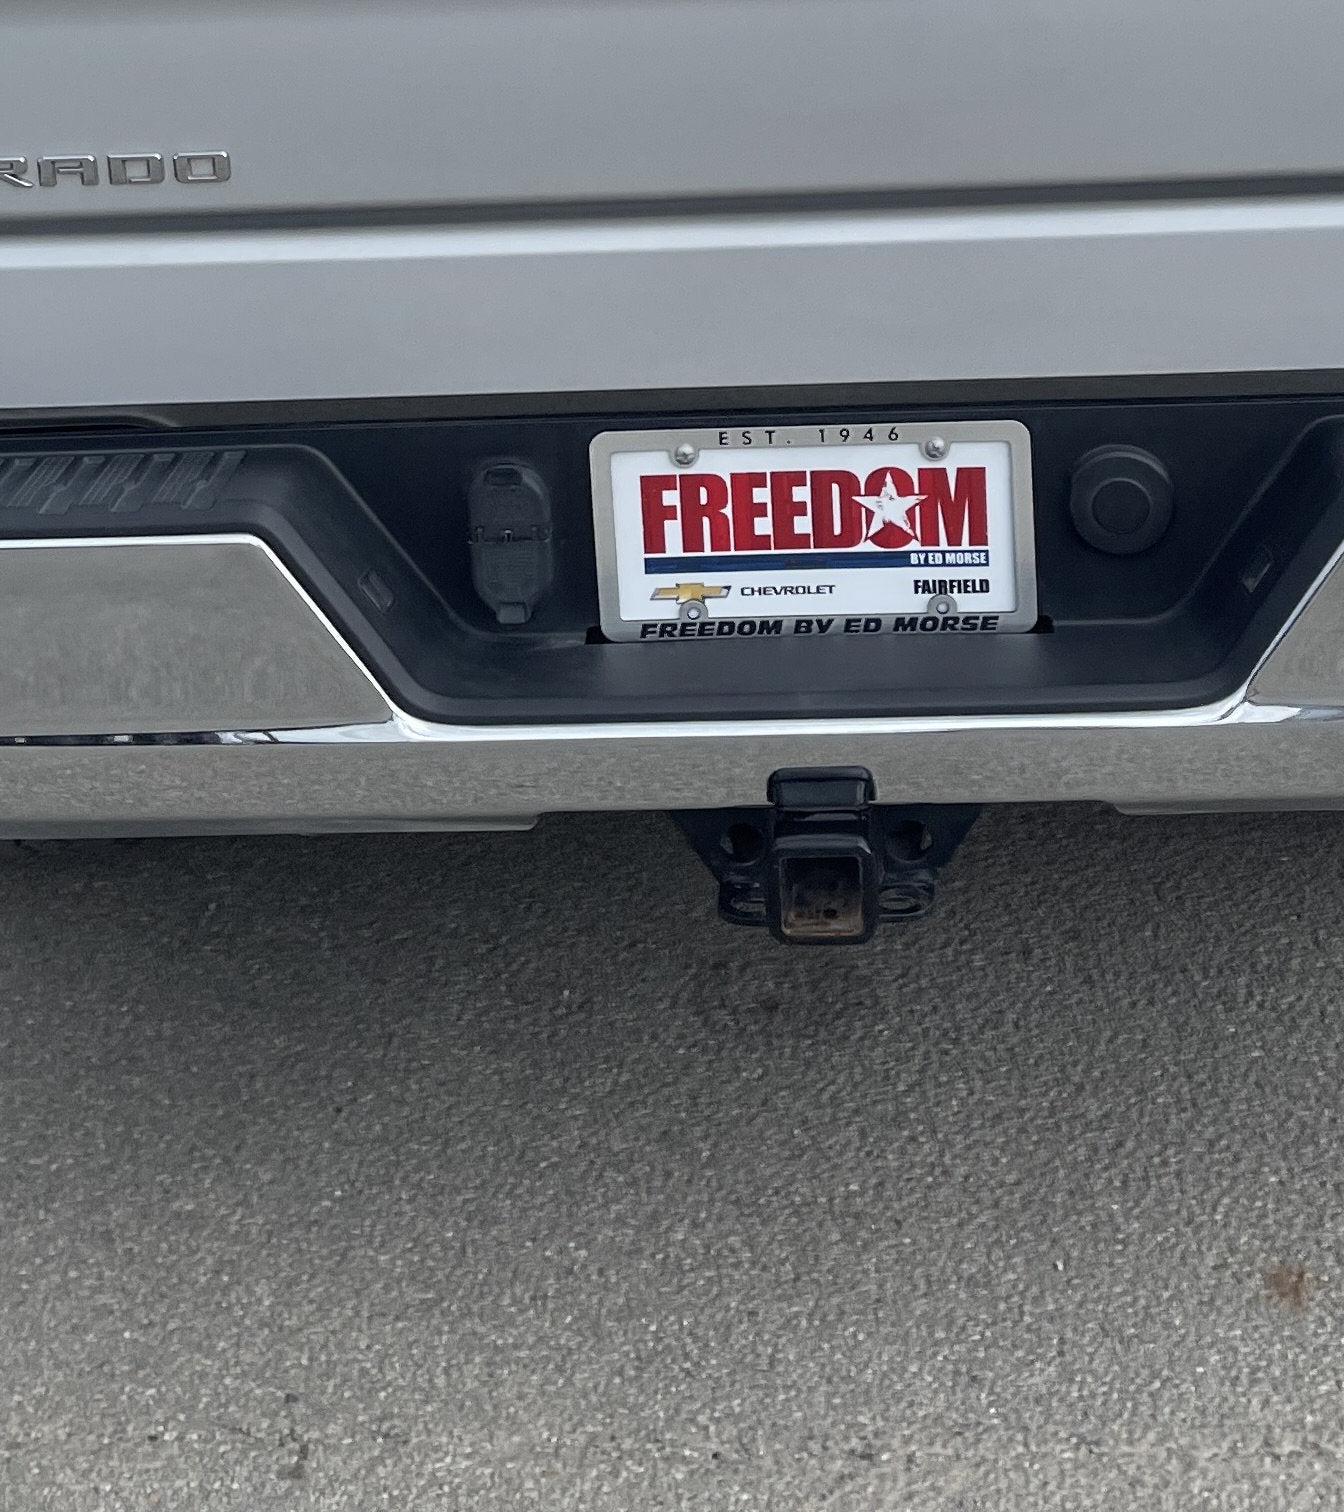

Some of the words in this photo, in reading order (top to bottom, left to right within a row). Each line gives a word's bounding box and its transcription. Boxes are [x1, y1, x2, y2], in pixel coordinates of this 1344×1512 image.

[719, 430, 791, 446] EST.
[819, 426, 899, 443] 1946
[640, 466, 989, 554] FREEDOM
[910, 553, 926, 565] BY
[927, 552, 943, 565] ED
[945, 551, 987, 565] MORSE
[740, 584, 836, 597] CHEVROLET
[913, 578, 990, 595] FAIRFIELD
[640, 619, 783, 639] FREEDOM
[792, 618, 834, 635] BY
[843, 617, 882, 634] ED
[892, 615, 1000, 633] MORSE
